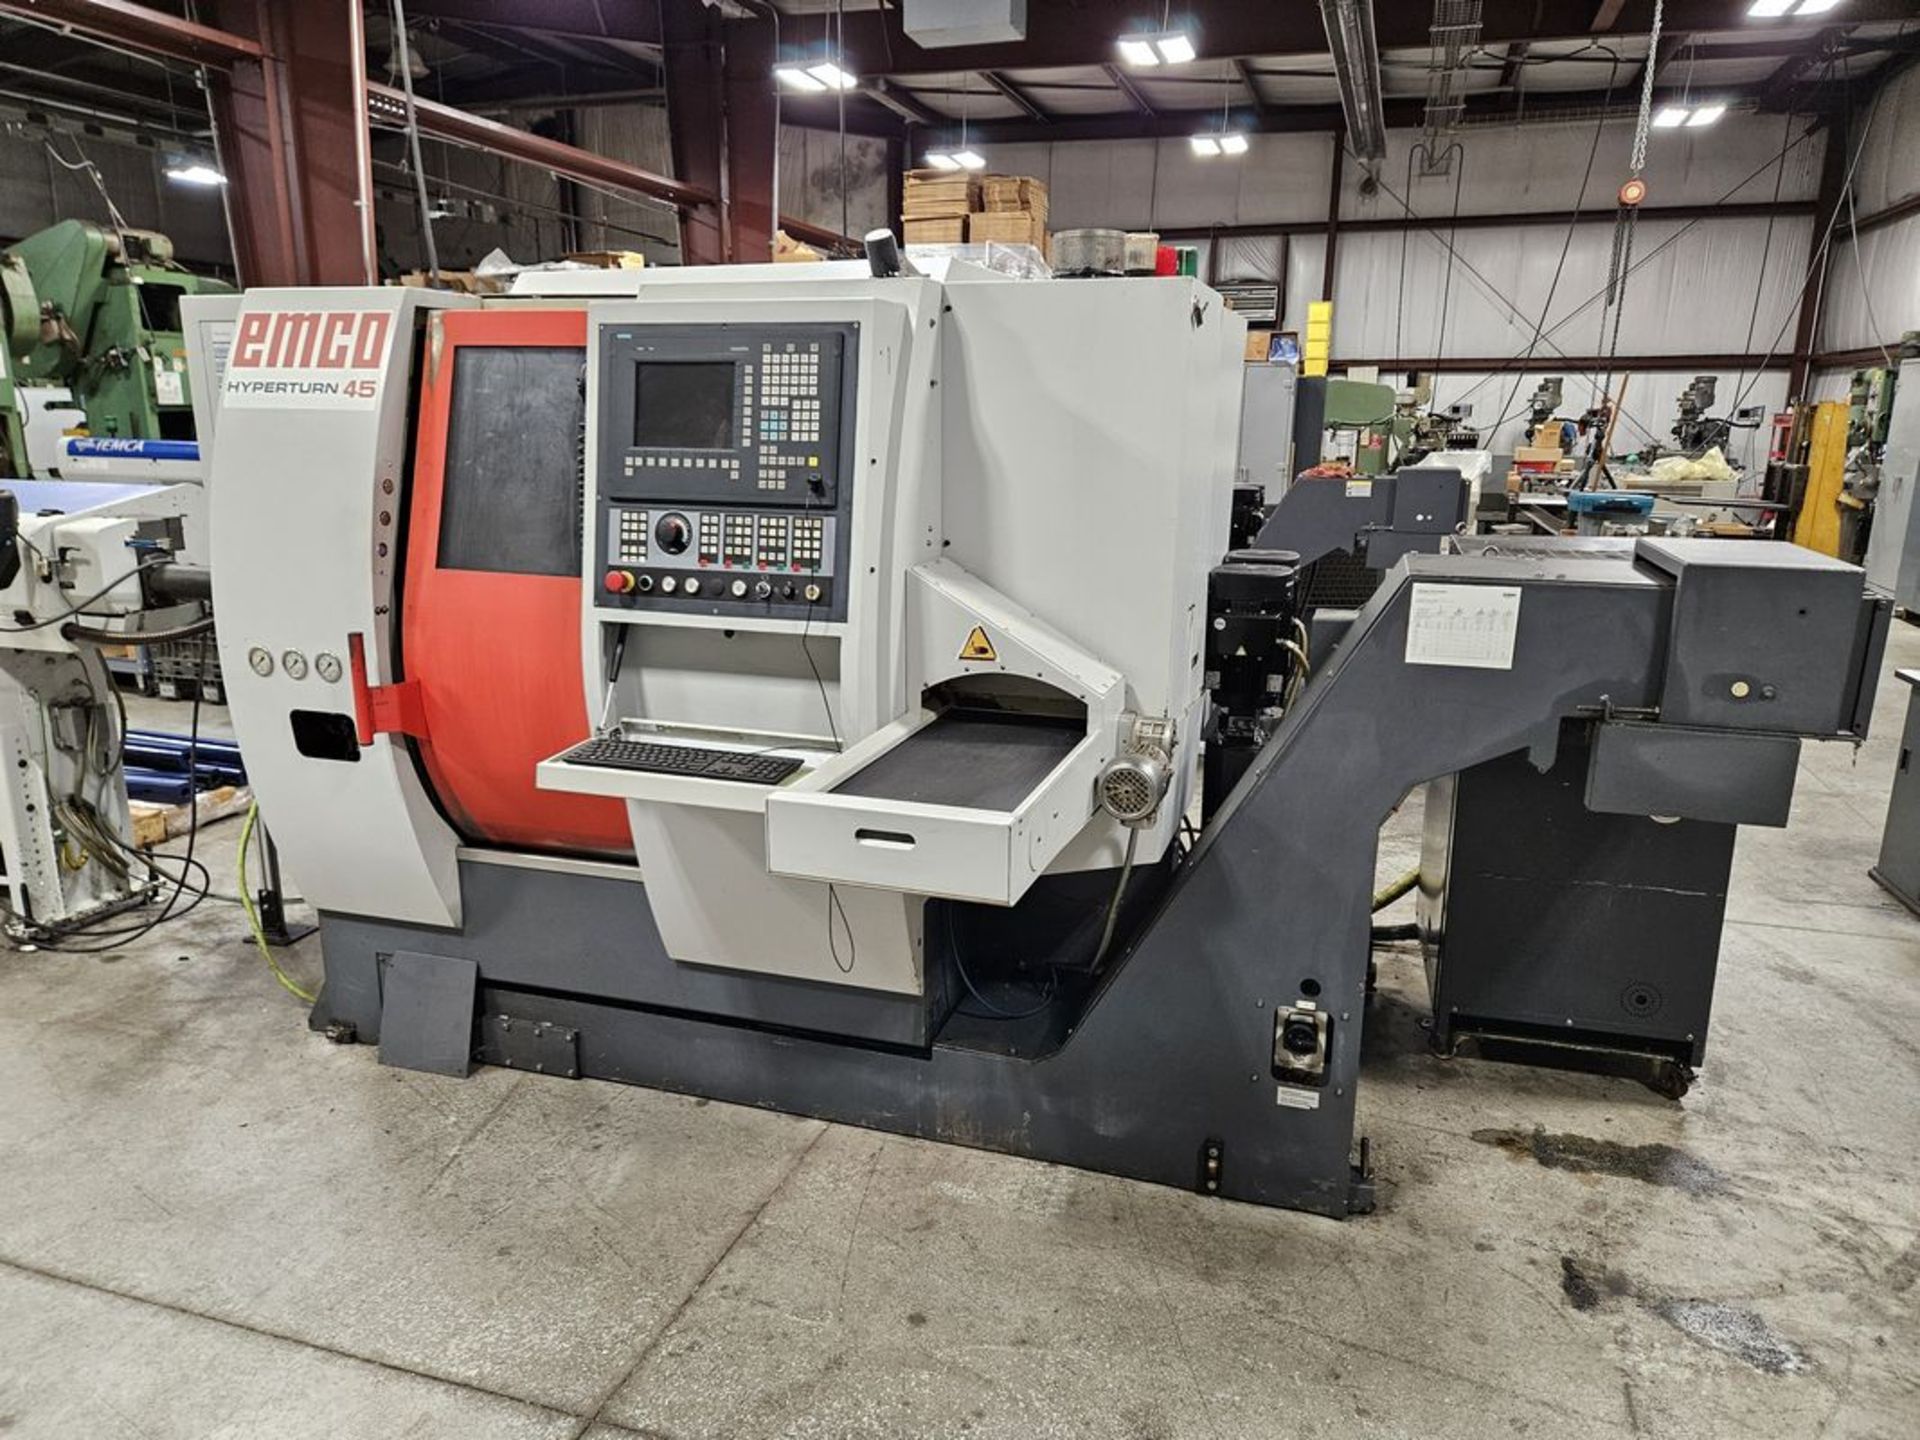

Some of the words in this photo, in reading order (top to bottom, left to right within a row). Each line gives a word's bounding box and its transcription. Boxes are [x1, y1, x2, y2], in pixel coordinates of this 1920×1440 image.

[232, 313, 391, 369] emco
[227, 381, 339, 394] HYPERTURN
[343, 380, 377, 398] 45
